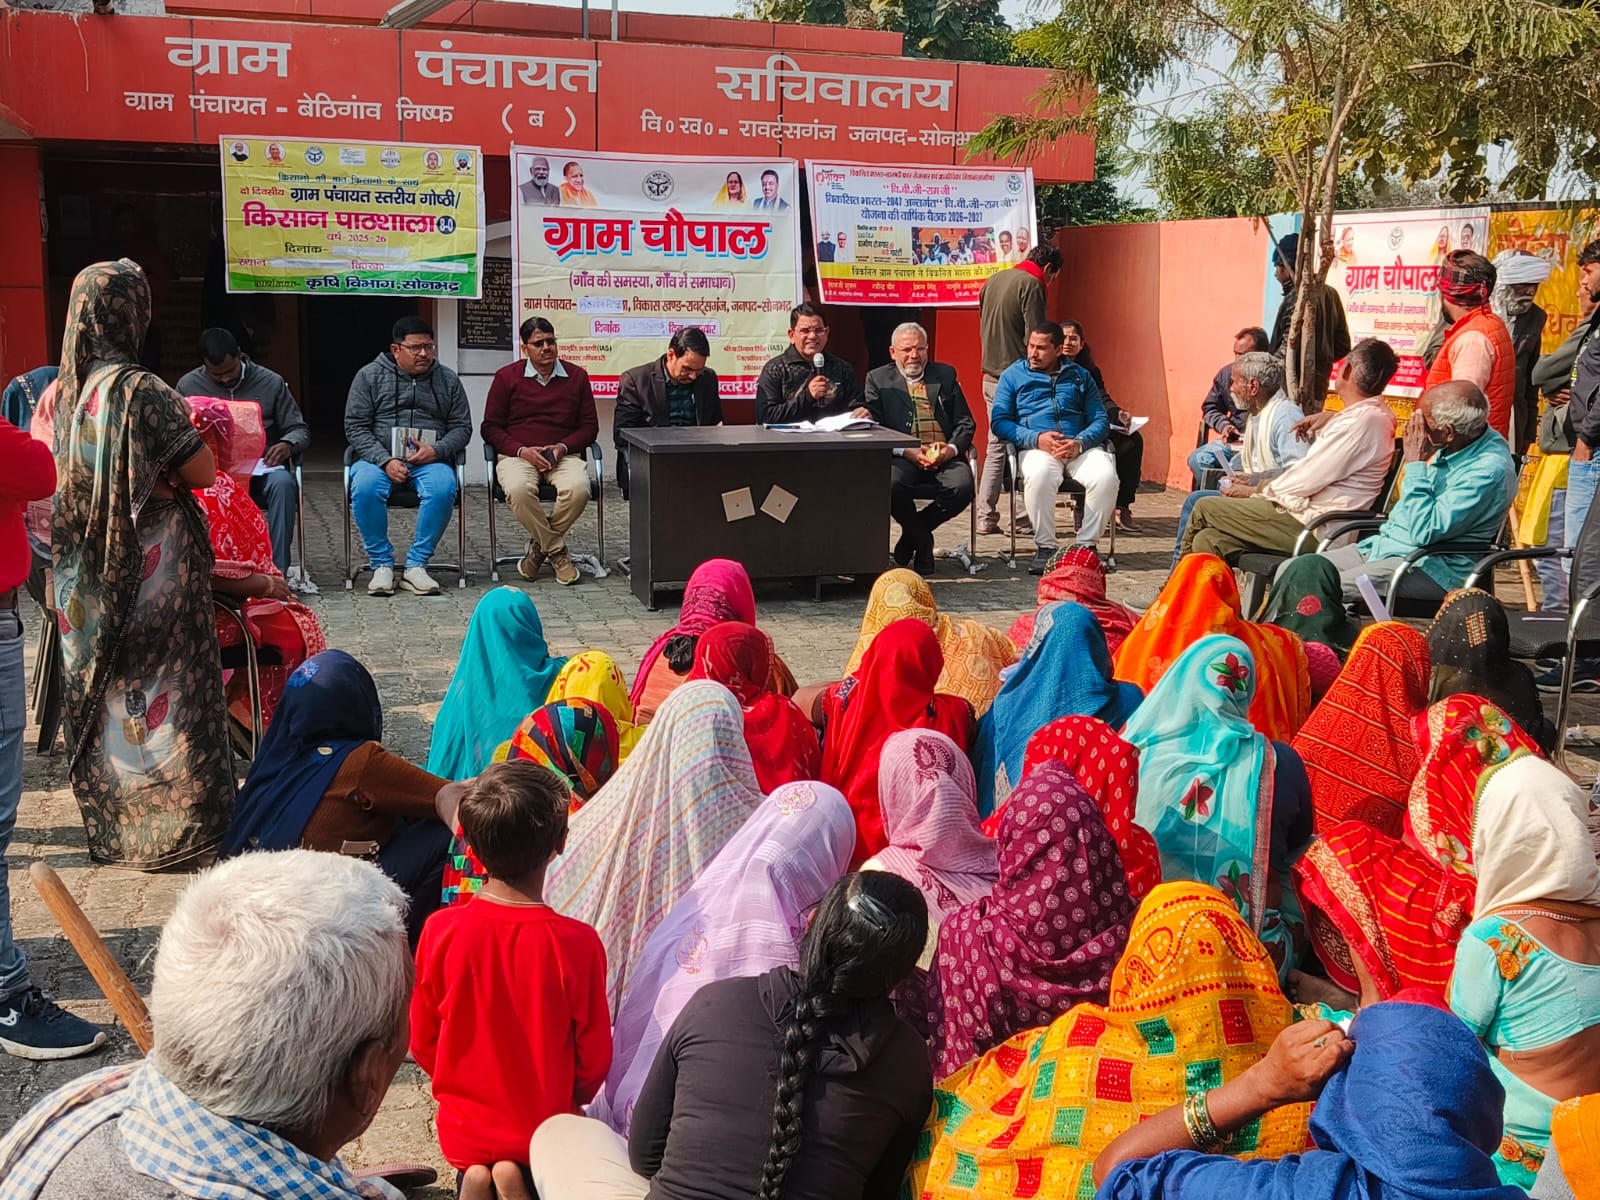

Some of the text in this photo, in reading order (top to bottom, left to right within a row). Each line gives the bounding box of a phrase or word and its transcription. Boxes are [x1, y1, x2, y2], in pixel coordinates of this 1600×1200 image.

[165, 37, 953, 112] ग्राम पंचायत सचिवालय
[124, 91, 174, 112] ग्राम
[189, 89, 267, 115] पंचायत
[290, 187, 320, 203] ग्राम
[323, 184, 371, 203] पंचायत
[374, 186, 417, 205] स्तरीय
[825, 192, 859, 204] विकसित
[242, 200, 328, 229] किसान
[335, 211, 436, 233] पाठशाला
[861, 207, 886, 220] योजना
[888, 207, 899, 219] की
[543, 207, 771, 260] ग्राम चौपाल
[306, 275, 340, 290] कृषि
[597, 271, 611, 288] की
[656, 272, 677, 288] गाँव
[1346, 254, 1440, 295] ग्राम चौपाल
[524, 298, 541, 311] ग्राम
[633, 296, 660, 312] विकास
